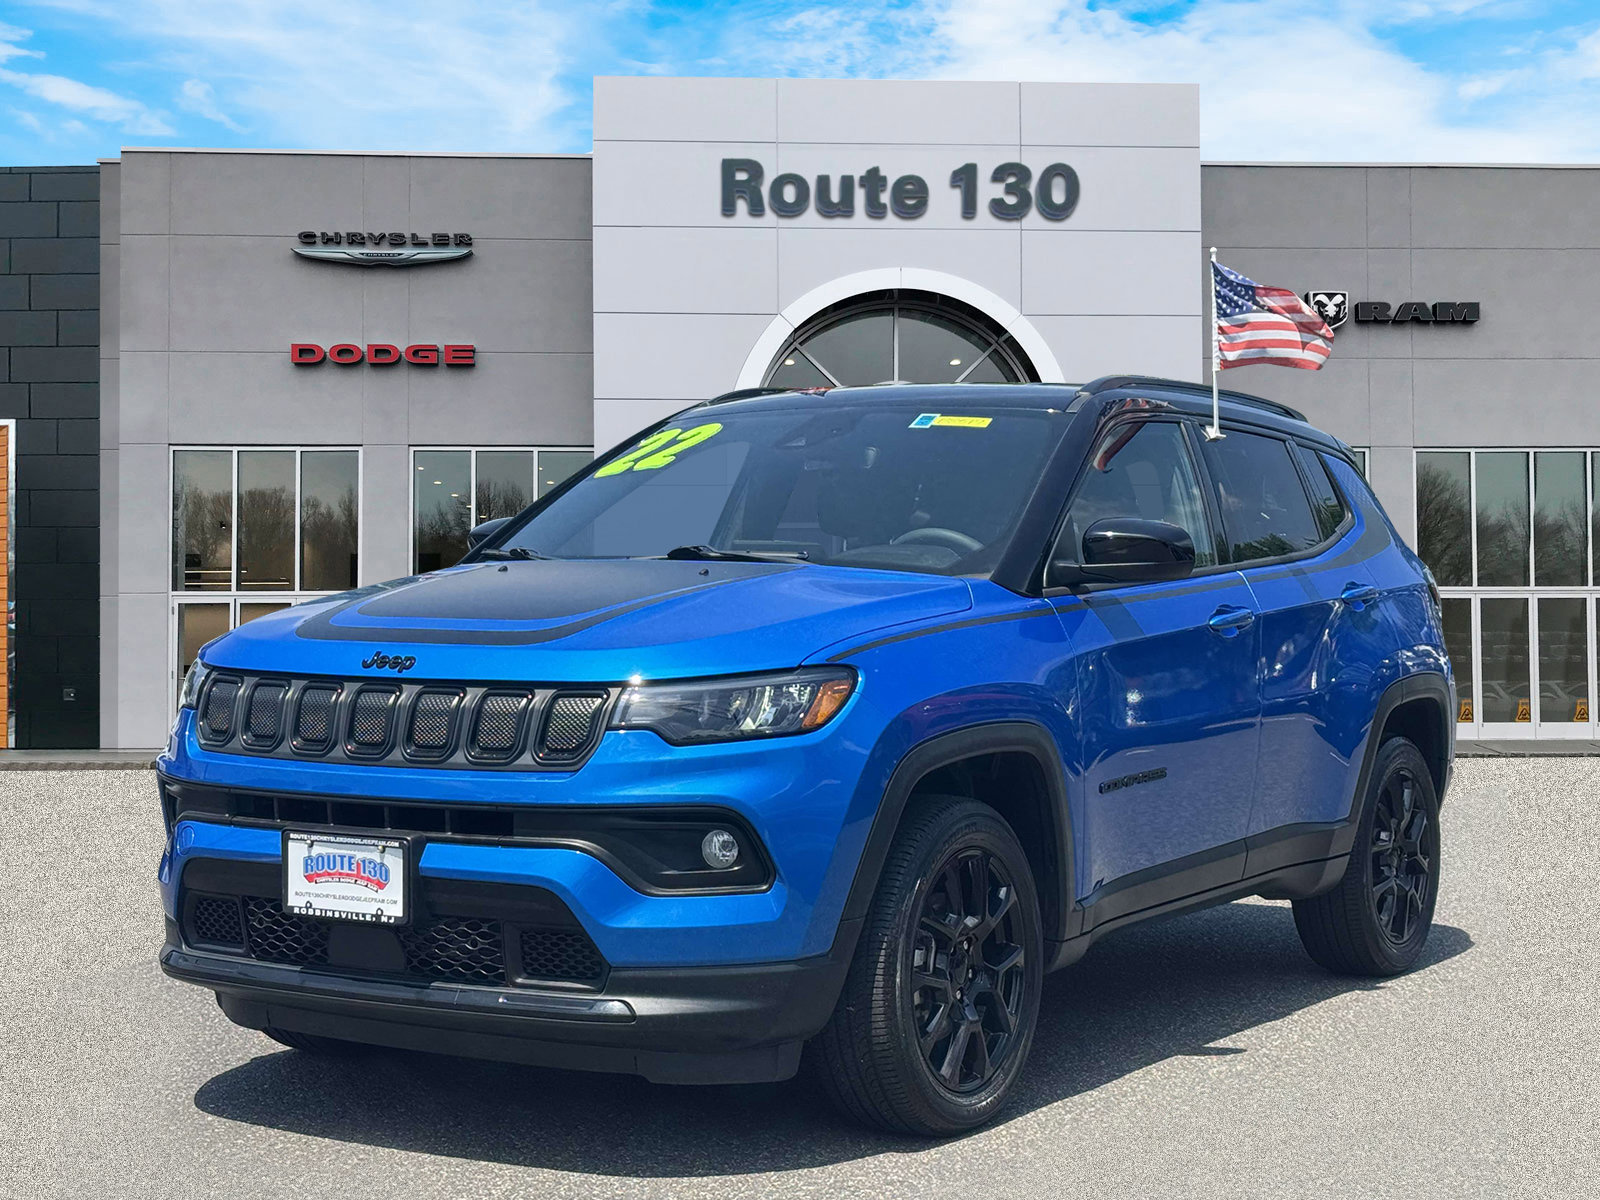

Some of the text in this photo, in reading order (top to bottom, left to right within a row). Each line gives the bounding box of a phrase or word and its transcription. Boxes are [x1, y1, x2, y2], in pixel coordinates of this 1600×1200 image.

[721, 158, 1080, 220] Route 130
[298, 231, 473, 246] CHRYSLER
[1355, 301, 1480, 324] RAM
[291, 343, 476, 365] DODGE
[593, 422, 723, 478] 22
[362, 650, 417, 674] Jeep
[303, 853, 390, 883] ROUTE 130
[381, 915, 396, 924] NJ
